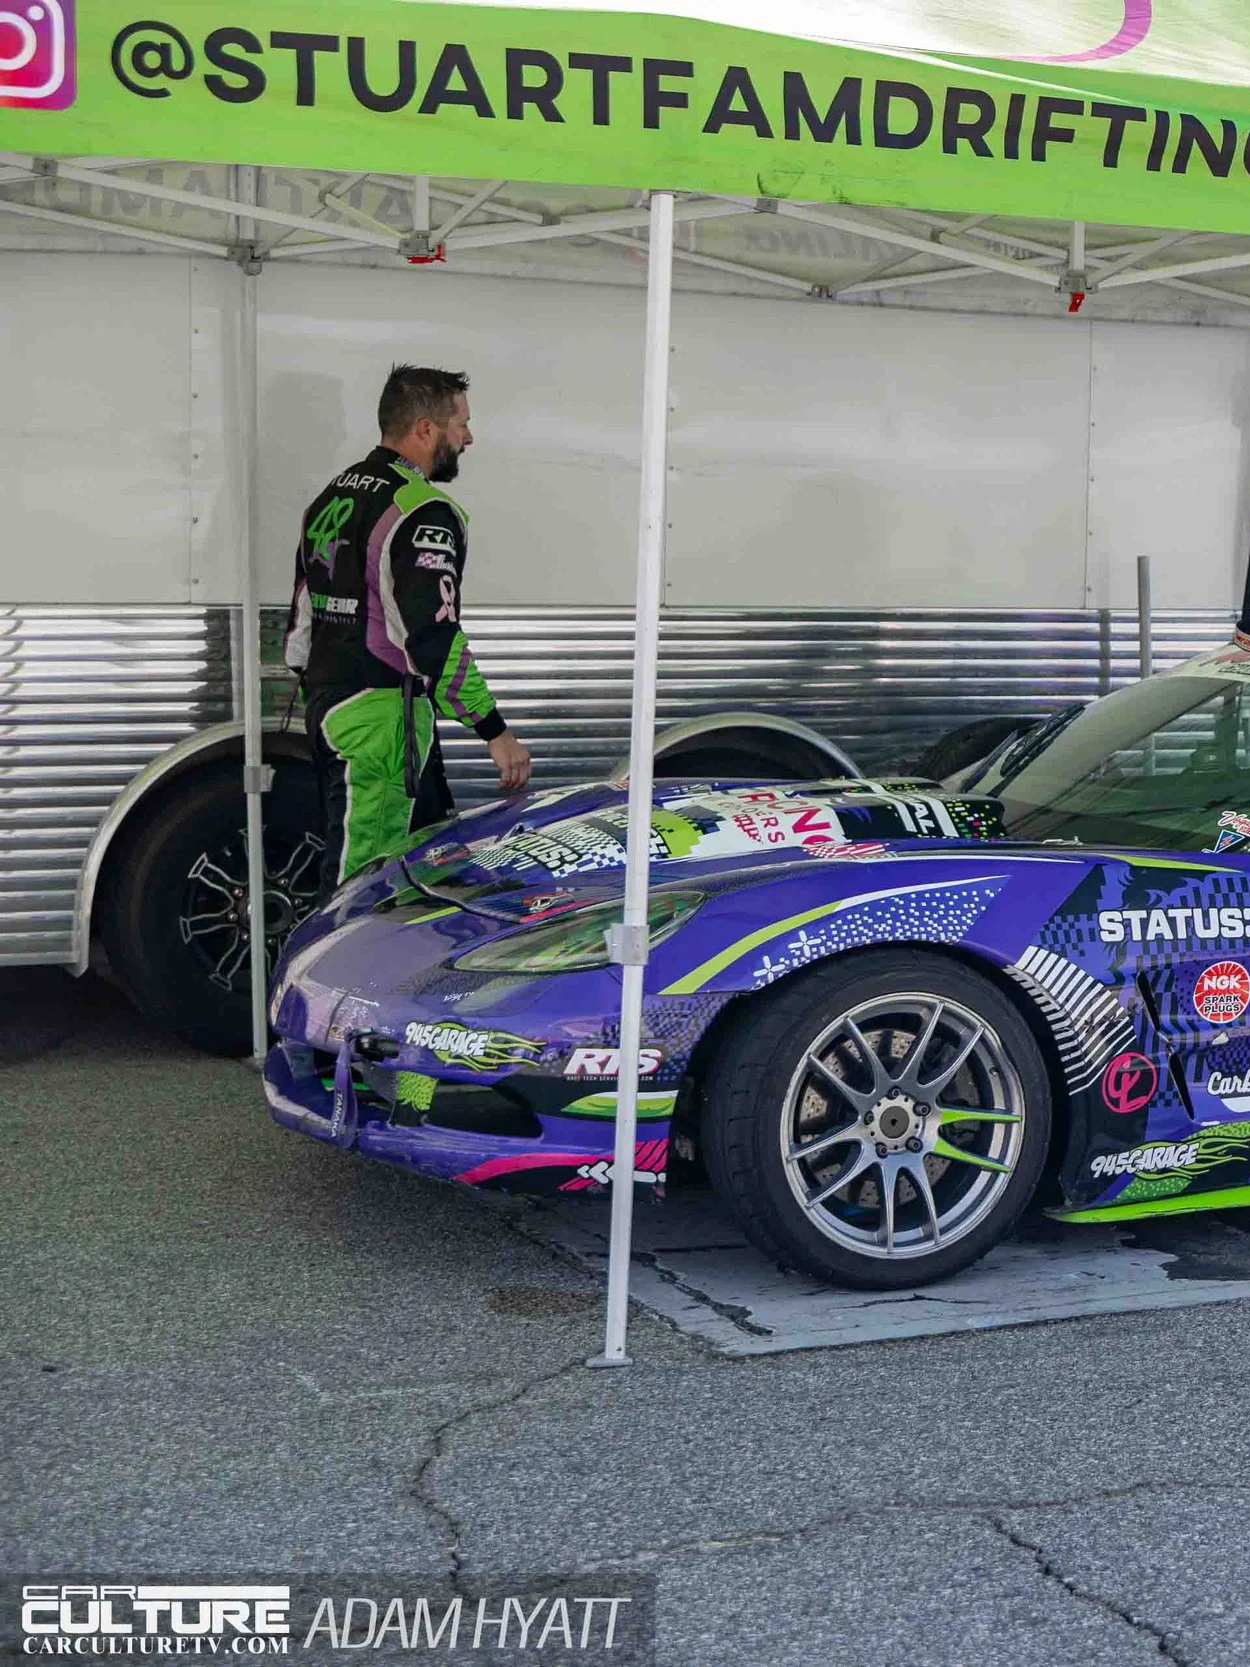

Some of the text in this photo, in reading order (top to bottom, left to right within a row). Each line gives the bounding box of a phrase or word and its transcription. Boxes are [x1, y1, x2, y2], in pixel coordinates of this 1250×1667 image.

[331, 472, 390, 493] UART
[1203, 974, 1242, 991] NGK
[1204, 994, 1241, 1005] SPARK
[1204, 1004, 1240, 1014] PLUGS
[405, 1021, 490, 1057] 945GARAGE
[1090, 1142, 1201, 1178] 945GARAGE
